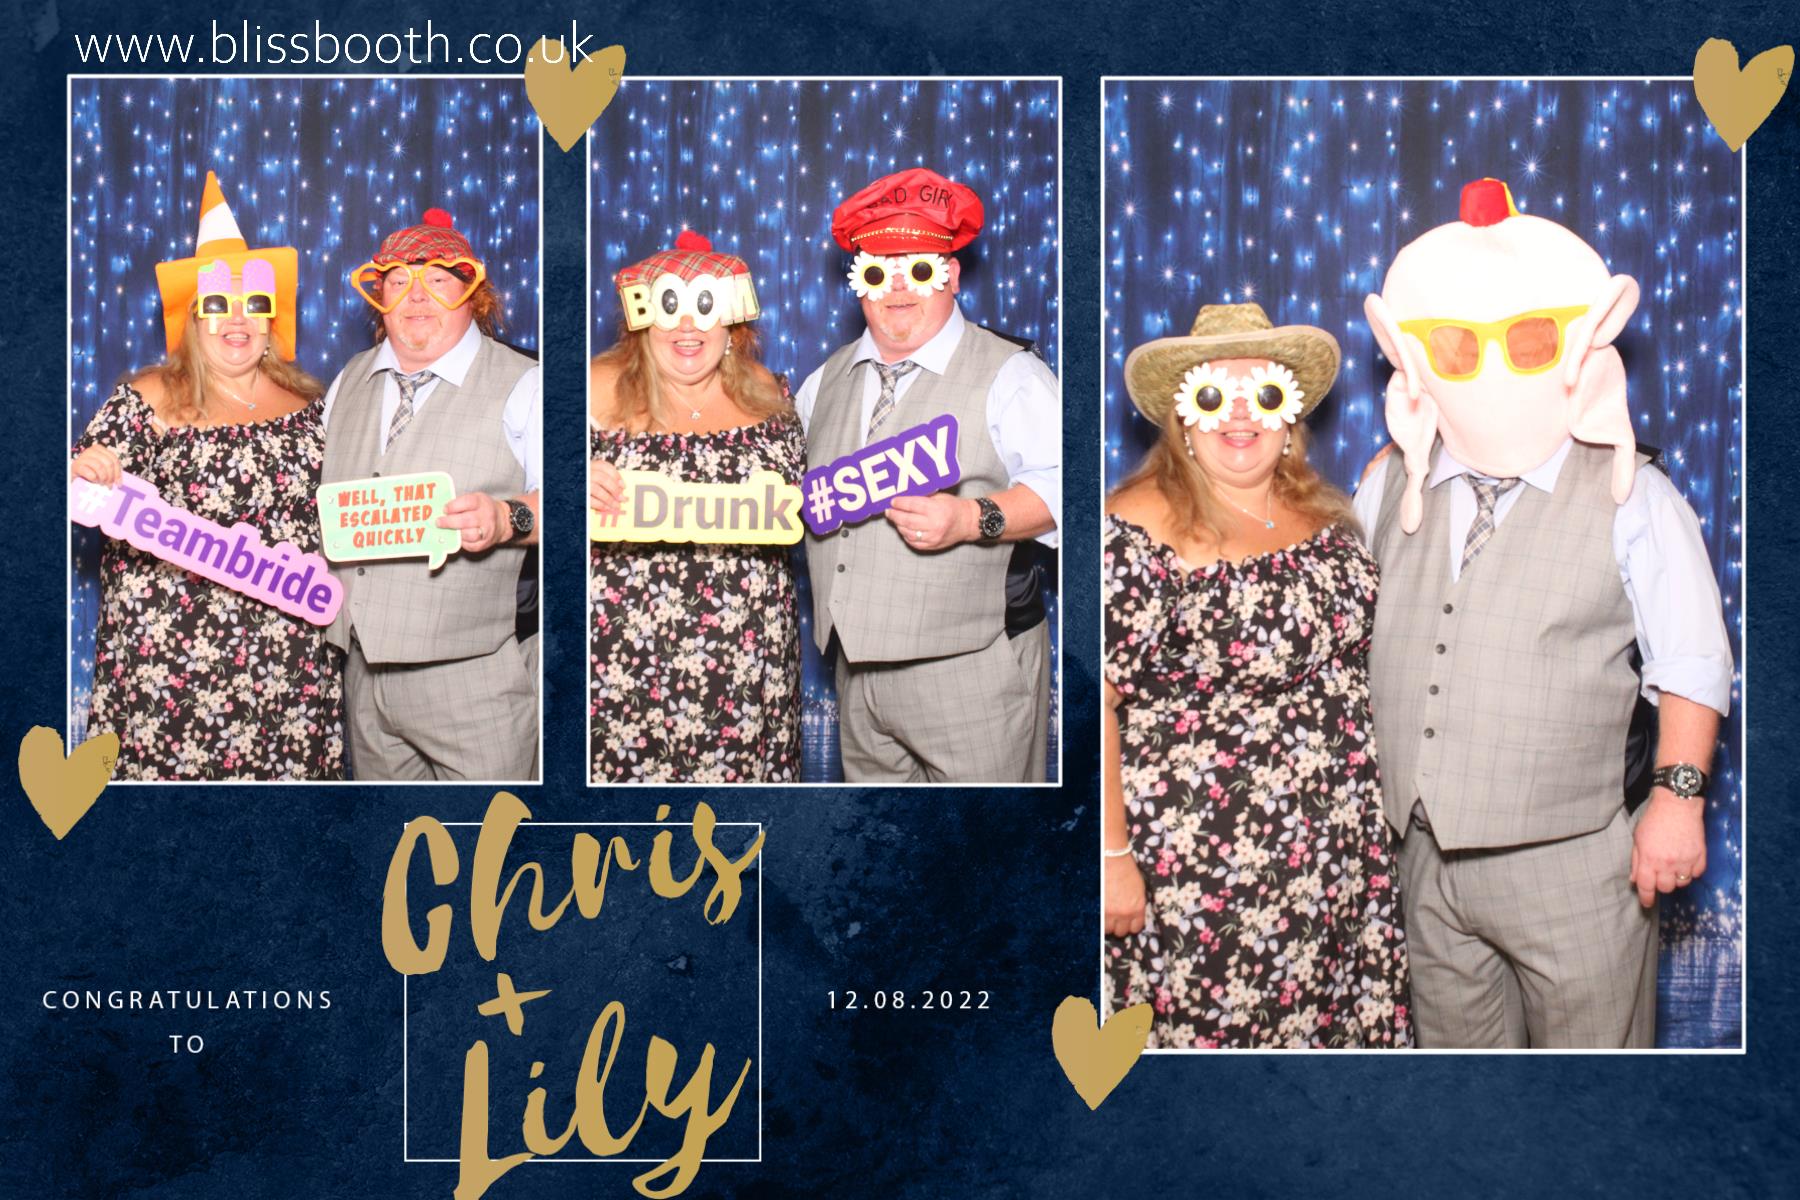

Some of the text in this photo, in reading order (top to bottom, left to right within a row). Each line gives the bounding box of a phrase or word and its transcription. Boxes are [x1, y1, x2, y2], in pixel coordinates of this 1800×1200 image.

[620, 273, 760, 332] BOOM
[338, 483, 436, 507] WELL, THAT
[808, 426, 952, 524] #SEXY
[340, 505, 433, 528] ESCALATED
[78, 485, 333, 613] #Teambride
[353, 528, 425, 549] QUICKLY
